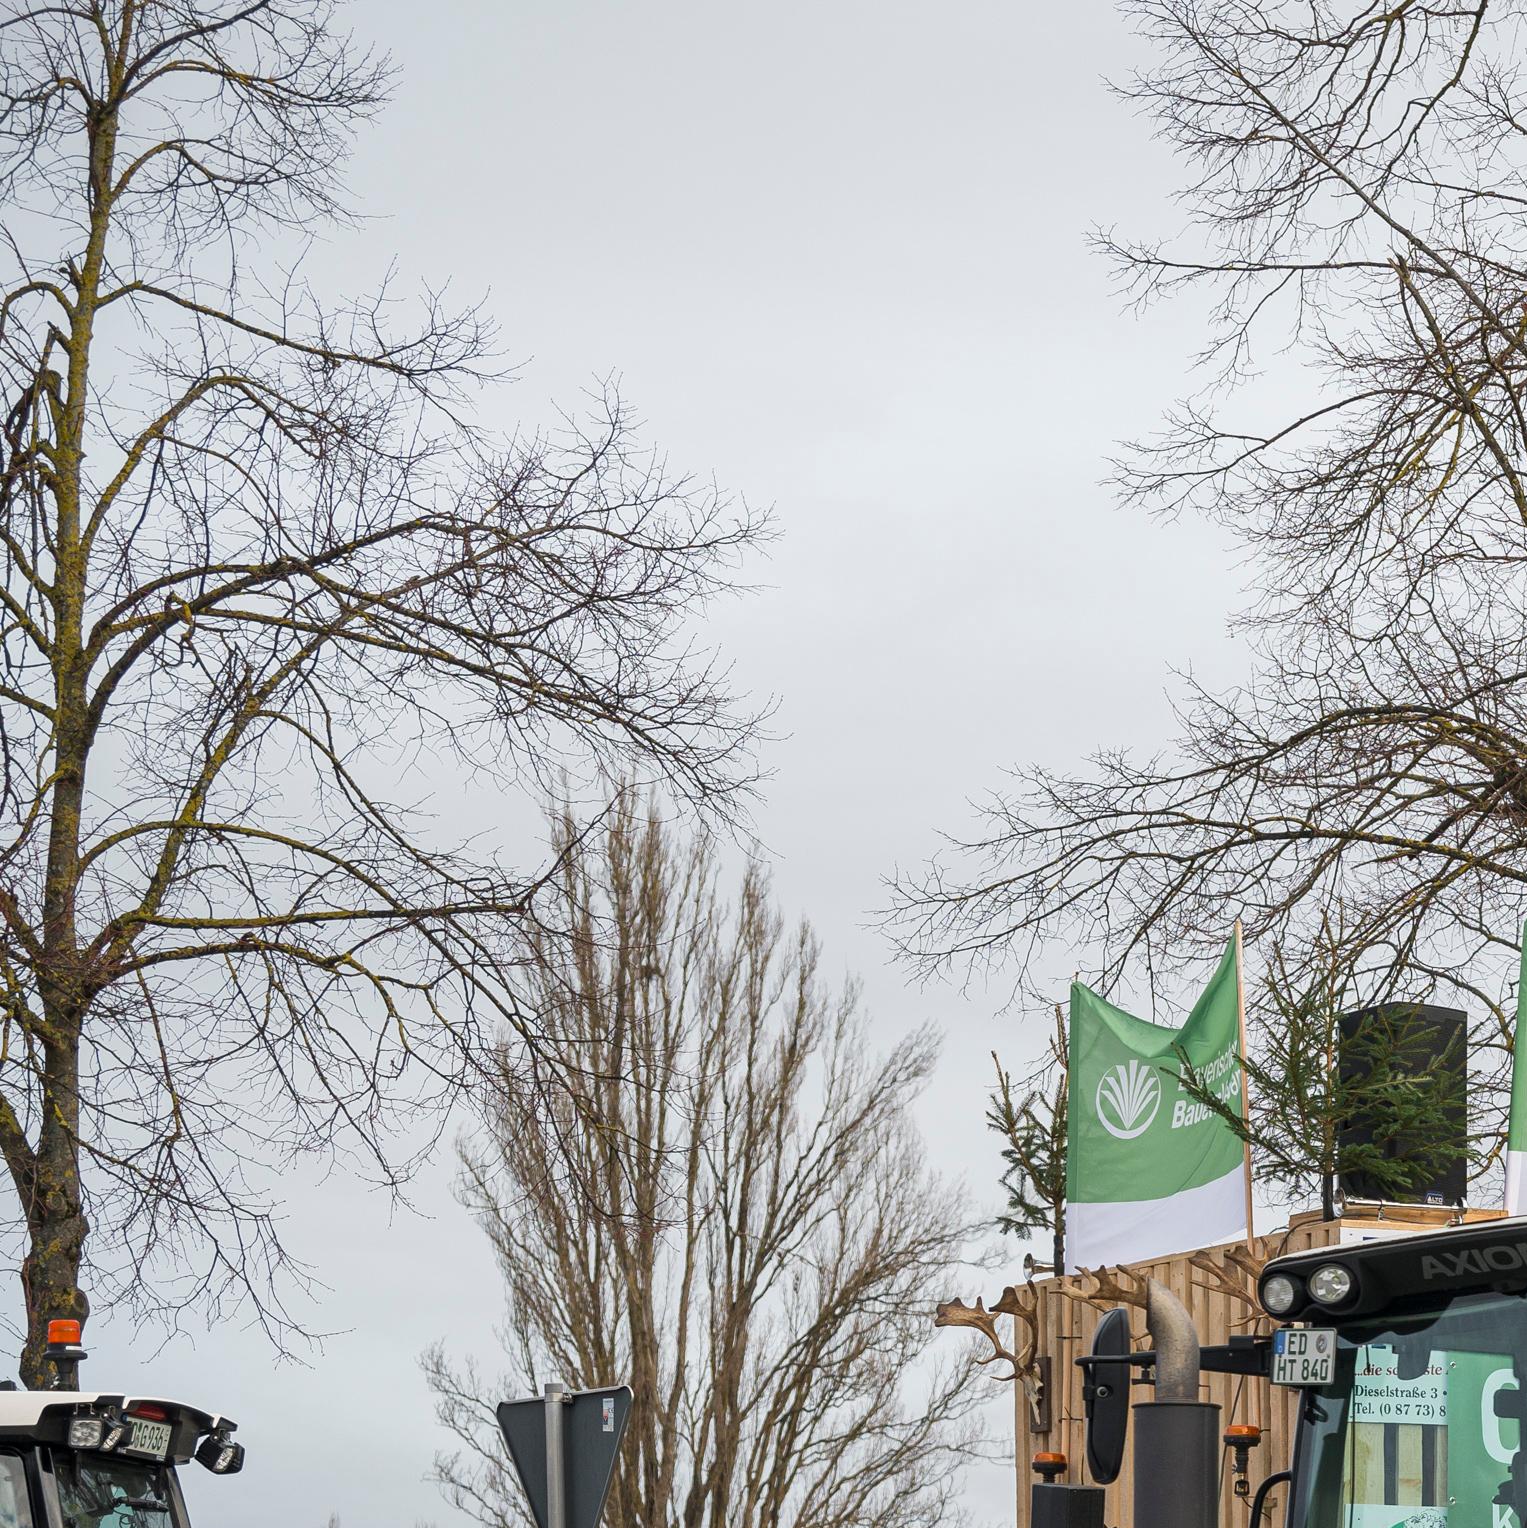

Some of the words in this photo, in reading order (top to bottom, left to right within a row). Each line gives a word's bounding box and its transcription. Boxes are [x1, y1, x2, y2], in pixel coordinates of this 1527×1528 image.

[1288, 1333, 1307, 1354] ED
[1277, 1358, 1297, 1382] HT
[1301, 1358, 1328, 1382] 840
[1354, 1385, 1427, 1400] Dieselstraße
[1430, 1387, 1438, 1399] 3
[1354, 1403, 1375, 1415] Tel.
[1396, 1404, 1411, 1416] 87
[1416, 1404, 1435, 1418] 73)
